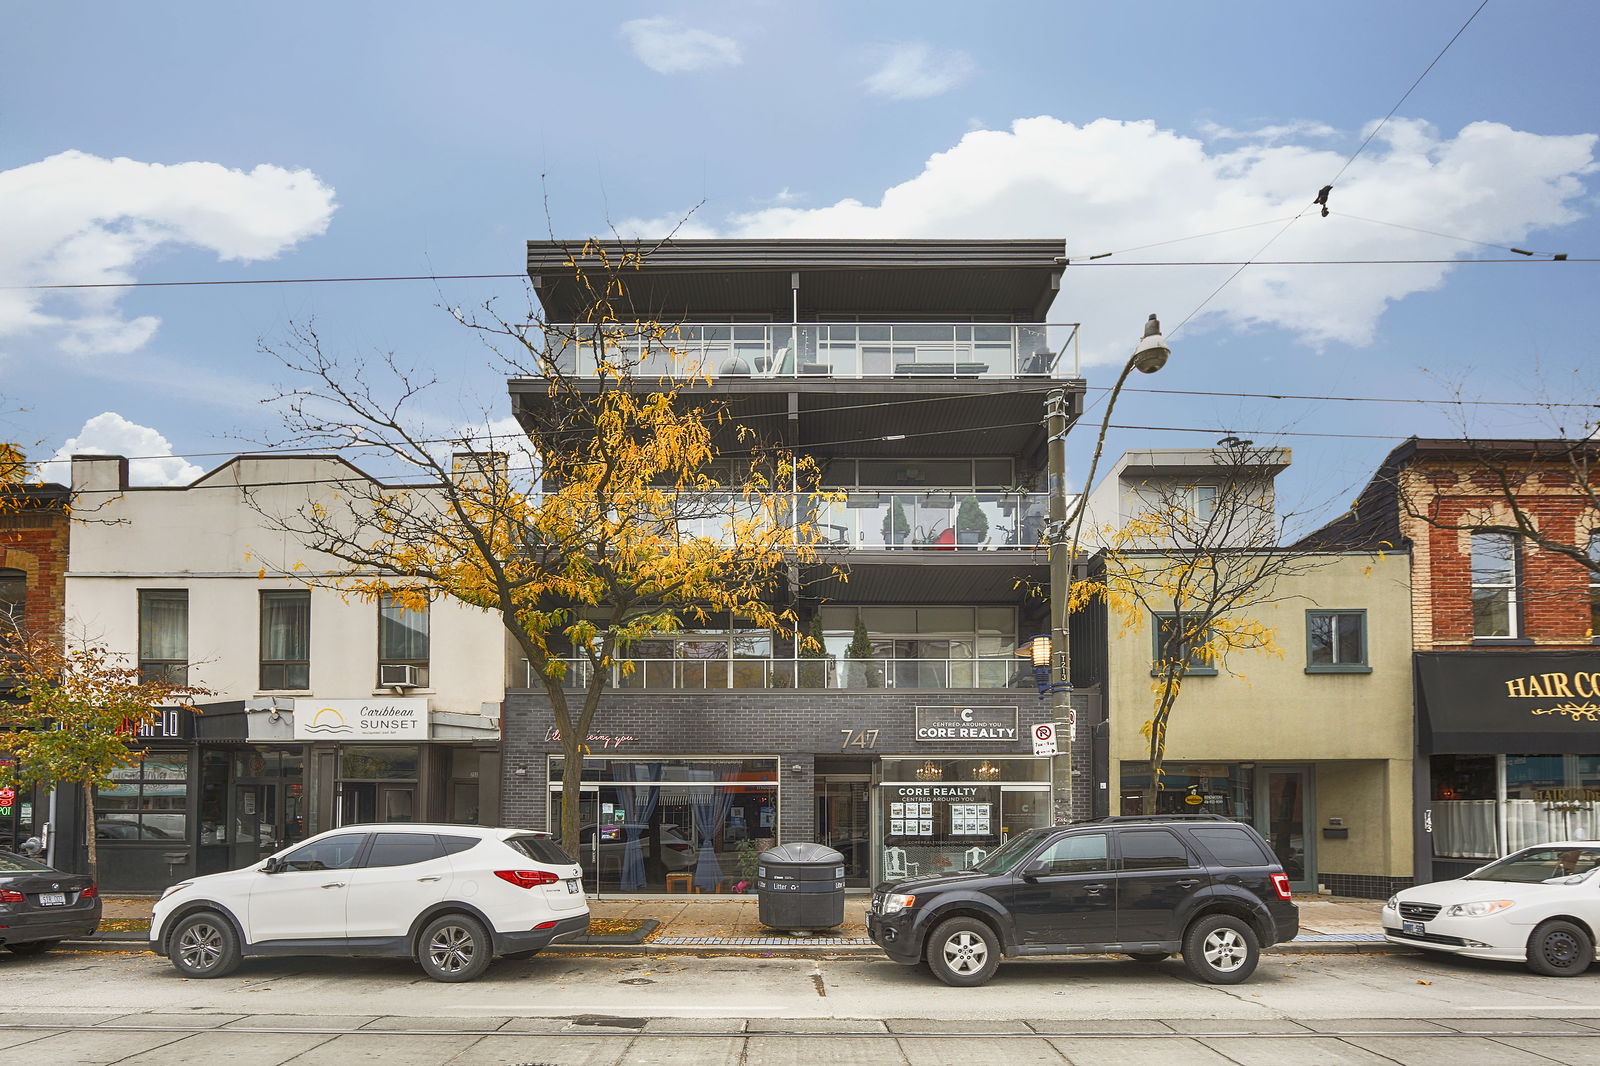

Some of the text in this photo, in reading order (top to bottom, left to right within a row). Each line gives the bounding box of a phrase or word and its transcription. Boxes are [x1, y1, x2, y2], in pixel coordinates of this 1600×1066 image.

[1505, 672, 1575, 698] HAIR
[360, 706, 414, 717] Caribbean
[961, 708, 973, 722] C
[360, 720, 418, 729] SUNSET
[918, 728, 1015, 738] CORE REALTY
[841, 729, 879, 749] 747
[898, 787, 977, 796] CORE REALTY
[1535, 789, 1566, 801] HAIR
